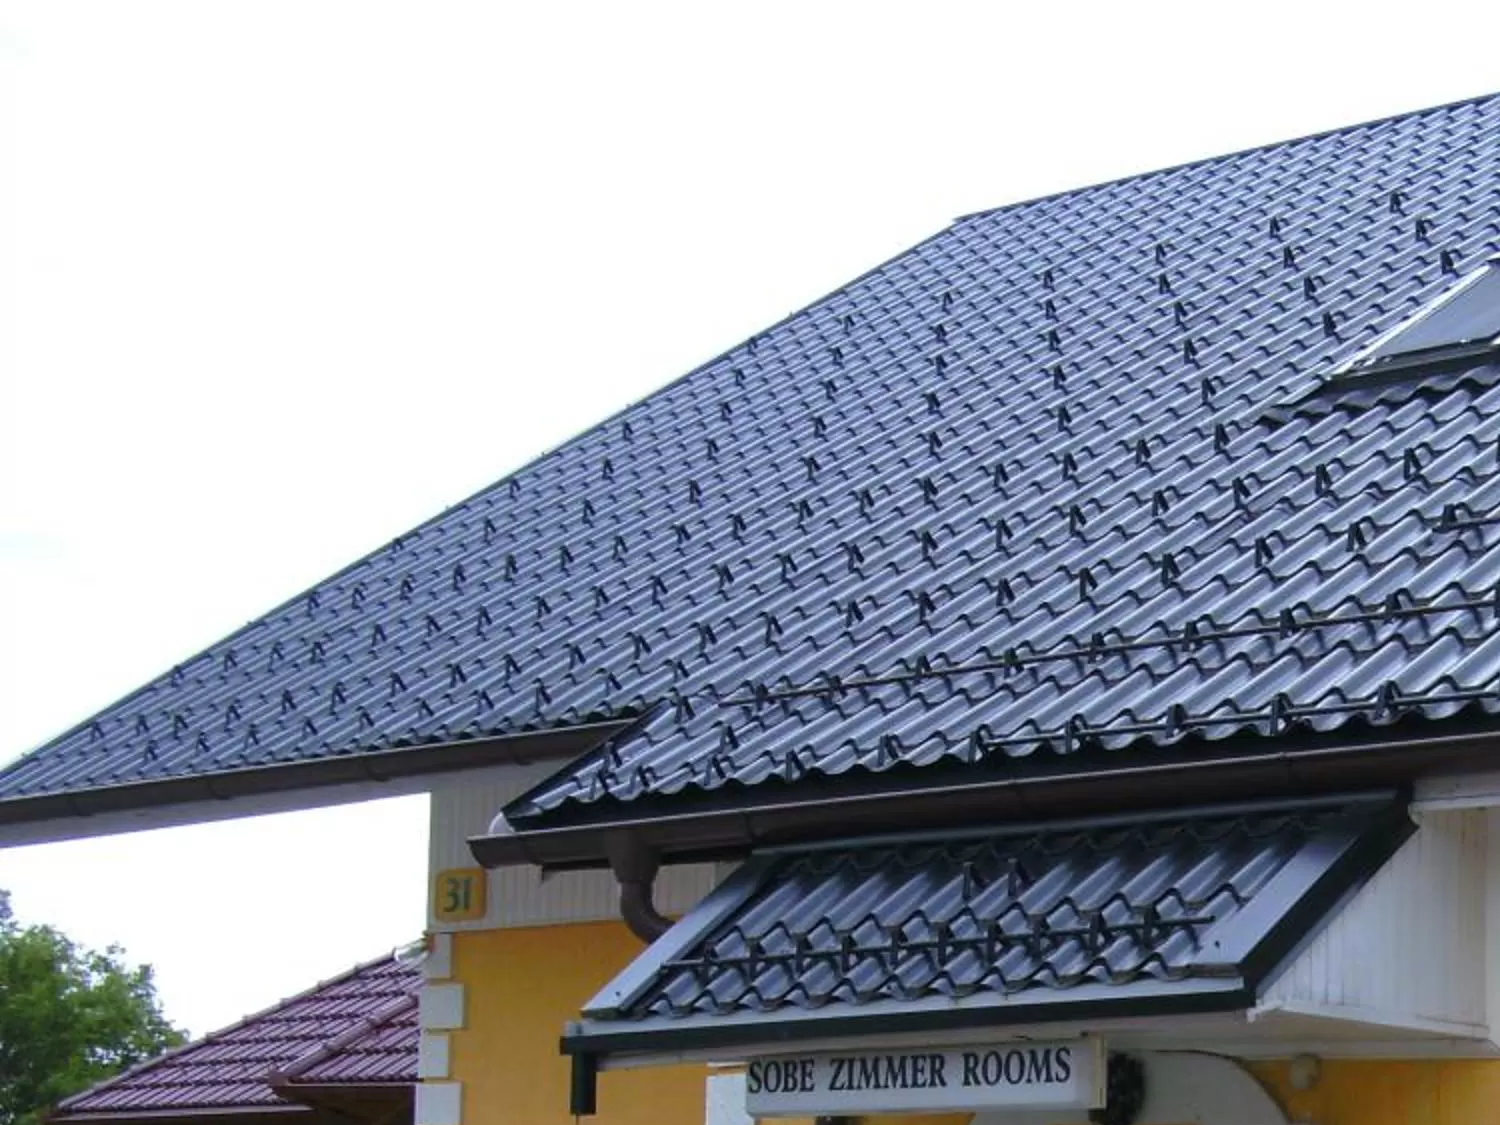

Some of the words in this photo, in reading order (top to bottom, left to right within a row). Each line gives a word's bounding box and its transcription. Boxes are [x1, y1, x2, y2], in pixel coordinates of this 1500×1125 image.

[443, 877, 472, 913] 31
[748, 1059, 815, 1094] SOBE
[828, 1054, 947, 1091] ZIMMER
[961, 1047, 1071, 1087] ROOMS
